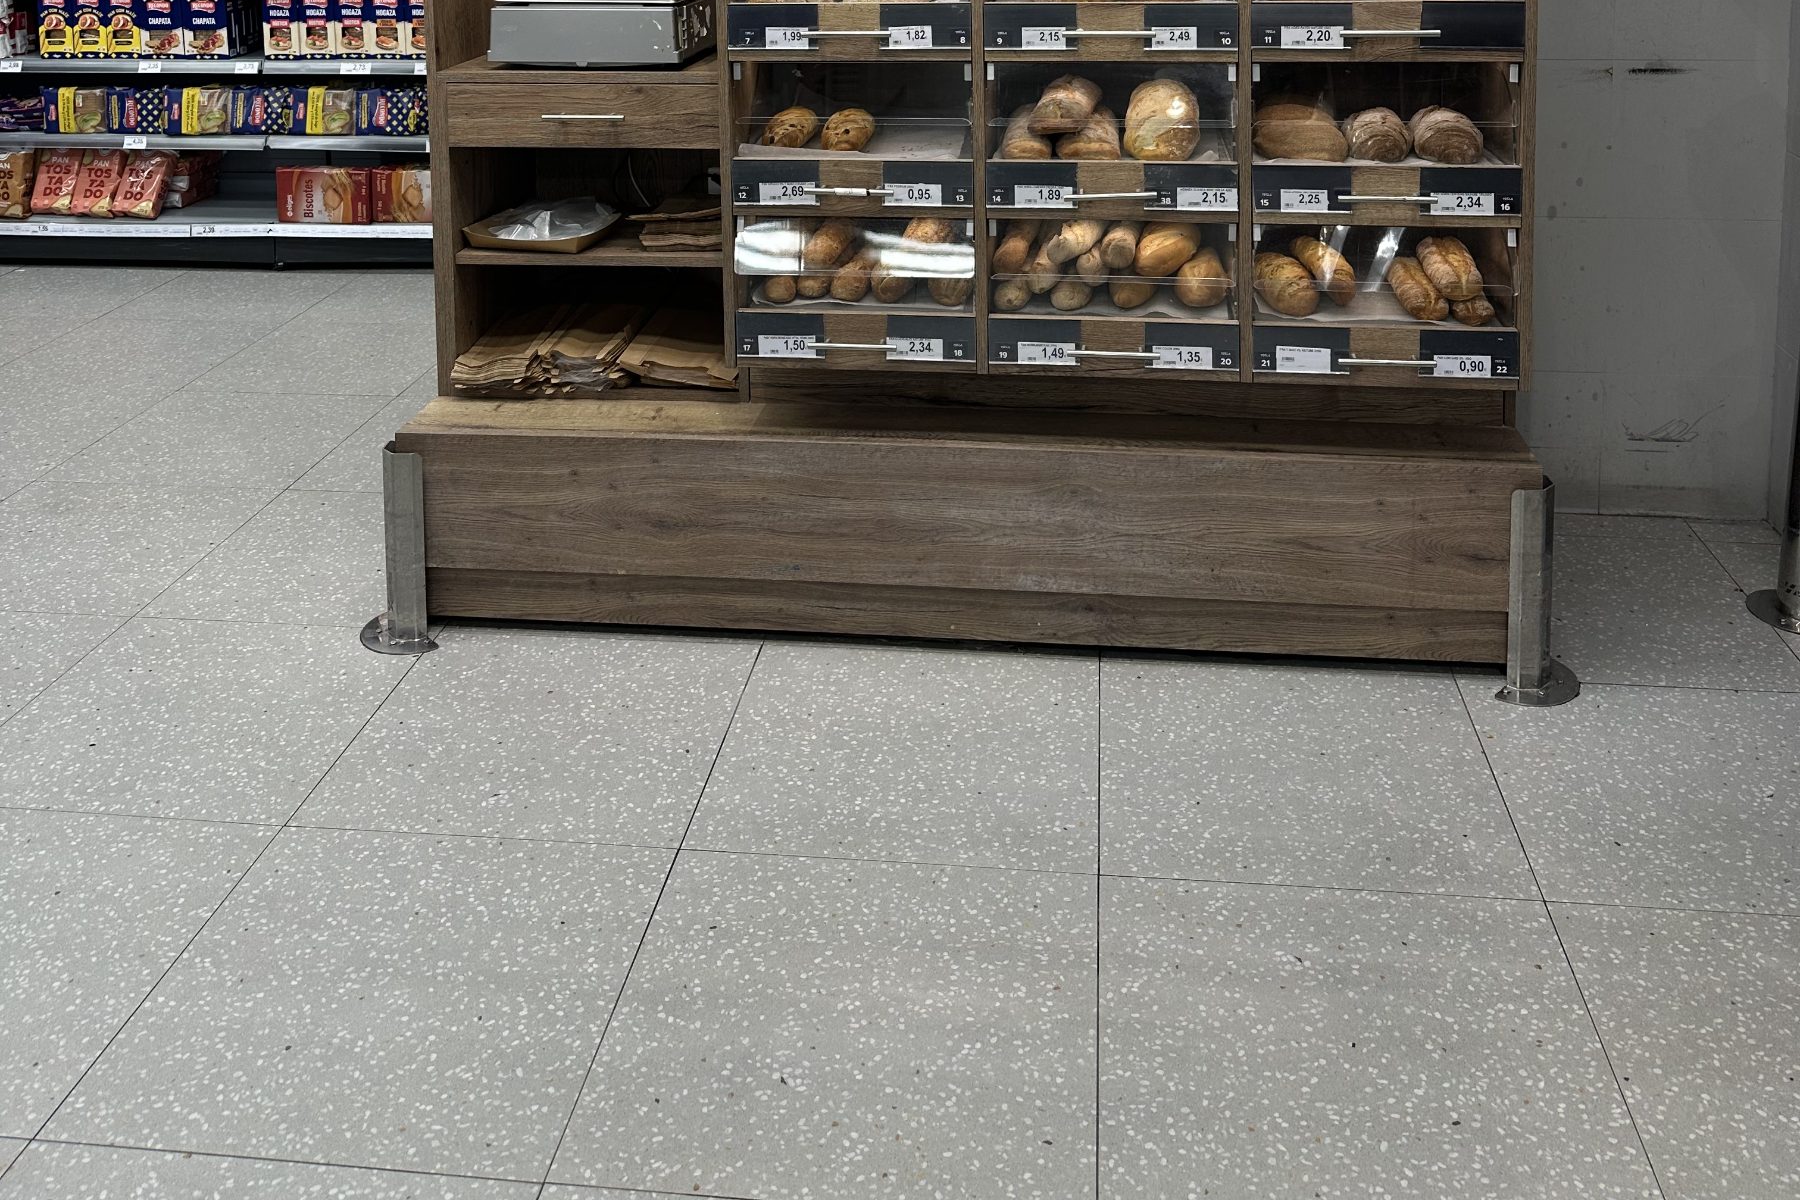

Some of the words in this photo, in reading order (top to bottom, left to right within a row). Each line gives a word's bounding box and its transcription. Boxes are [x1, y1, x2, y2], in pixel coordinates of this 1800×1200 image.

[342, 8, 361, 16] HOGAZA
[149, 17, 171, 25] CHAPATA
[193, 17, 215, 25] CHAPATA
[782, 32, 801, 43] 1,99
[906, 30, 926, 42] 1,82
[1040, 32, 1059, 43] 2,15
[1169, 32, 1190, 43] 2,49
[1306, 30, 1331, 44] 2,20
[52, 156, 70, 164] PAN
[93, 159, 110, 167] PAN
[45, 165, 71, 175] TOS
[87, 168, 112, 178] TOS
[47, 176, 63, 185] TA
[89, 179, 105, 188] TA
[43, 186, 62, 196] DO
[83, 188, 103, 198] DO
[124, 190, 143, 200] DO
[782, 186, 804, 199] 2,69
[908, 189, 930, 201] 0,95
[1038, 189, 1061, 202] 1,89
[304, 179, 314, 218] Biscotes
[1202, 192, 1226, 205] 2,15
[1299, 194, 1320, 206] 2,25
[1456, 196, 1481, 210] 2,34
[1500, 203, 1510, 211] 16
[784, 340, 804, 352] 1,50
[909, 342, 932, 354] 2,34
[1042, 347, 1064, 360] 1,49
[1177, 351, 1200, 364] 1,35
[1459, 360, 1484, 374] 0,90
